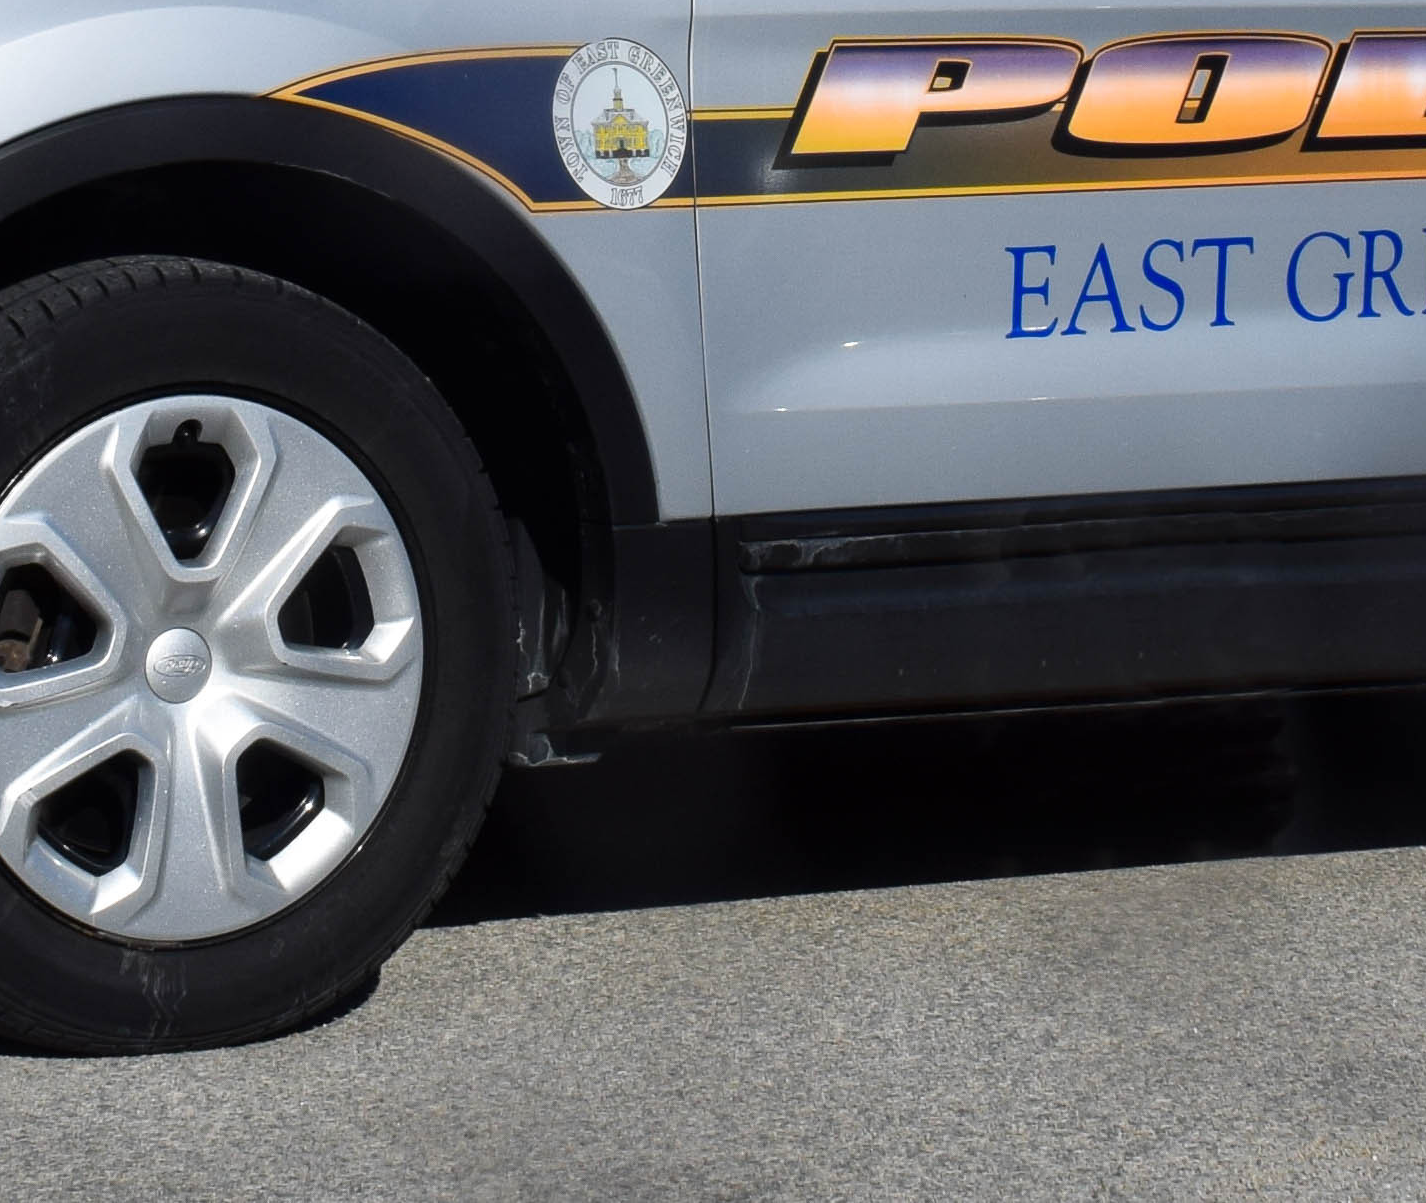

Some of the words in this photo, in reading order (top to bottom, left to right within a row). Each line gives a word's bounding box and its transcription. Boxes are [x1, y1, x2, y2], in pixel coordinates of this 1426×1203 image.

[558, 72, 575, 105] OF
[572, 41, 619, 75] EAST
[628, 45, 685, 178] GREENWICH
[554, 116, 588, 183] TOWN
[1004, 235, 1253, 339] EAST
